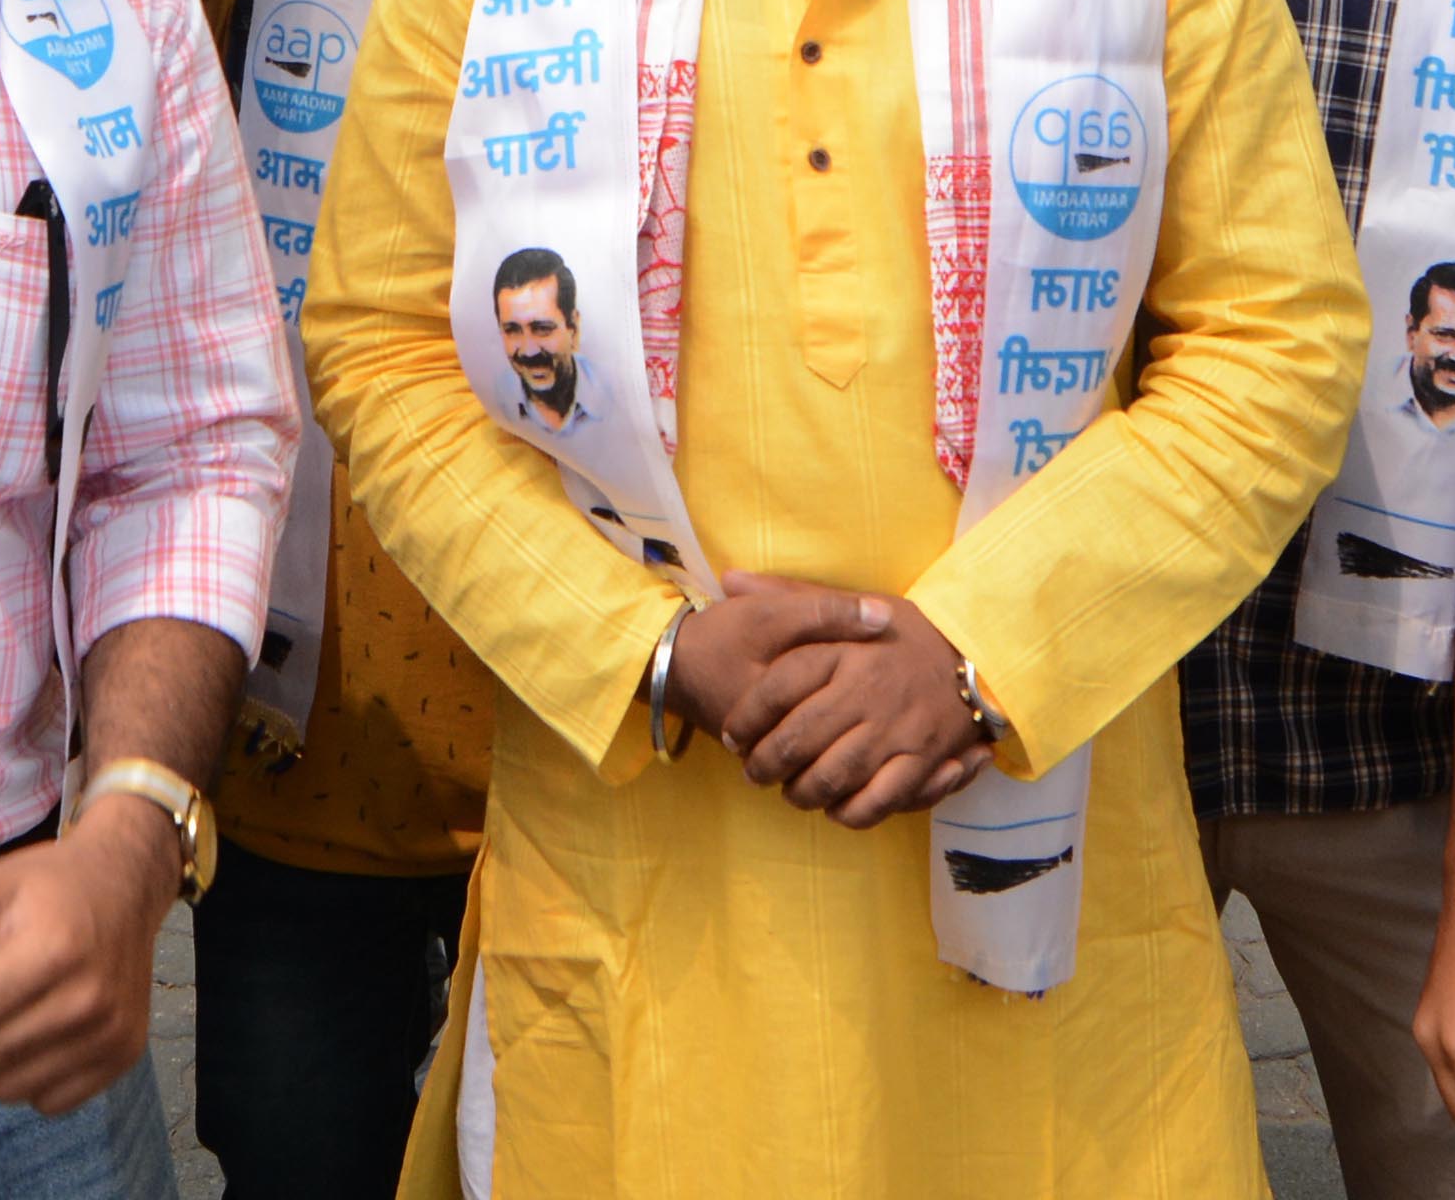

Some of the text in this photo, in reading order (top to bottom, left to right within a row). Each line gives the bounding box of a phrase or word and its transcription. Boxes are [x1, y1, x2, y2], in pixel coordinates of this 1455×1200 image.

[266, 23, 345, 91] aap
[462, 28, 603, 99] आदमी
[273, 106, 315, 125] PARTY
[289, 89, 338, 112] AADMI
[256, 148, 325, 194] आम
[484, 111, 586, 176] पार्टी
